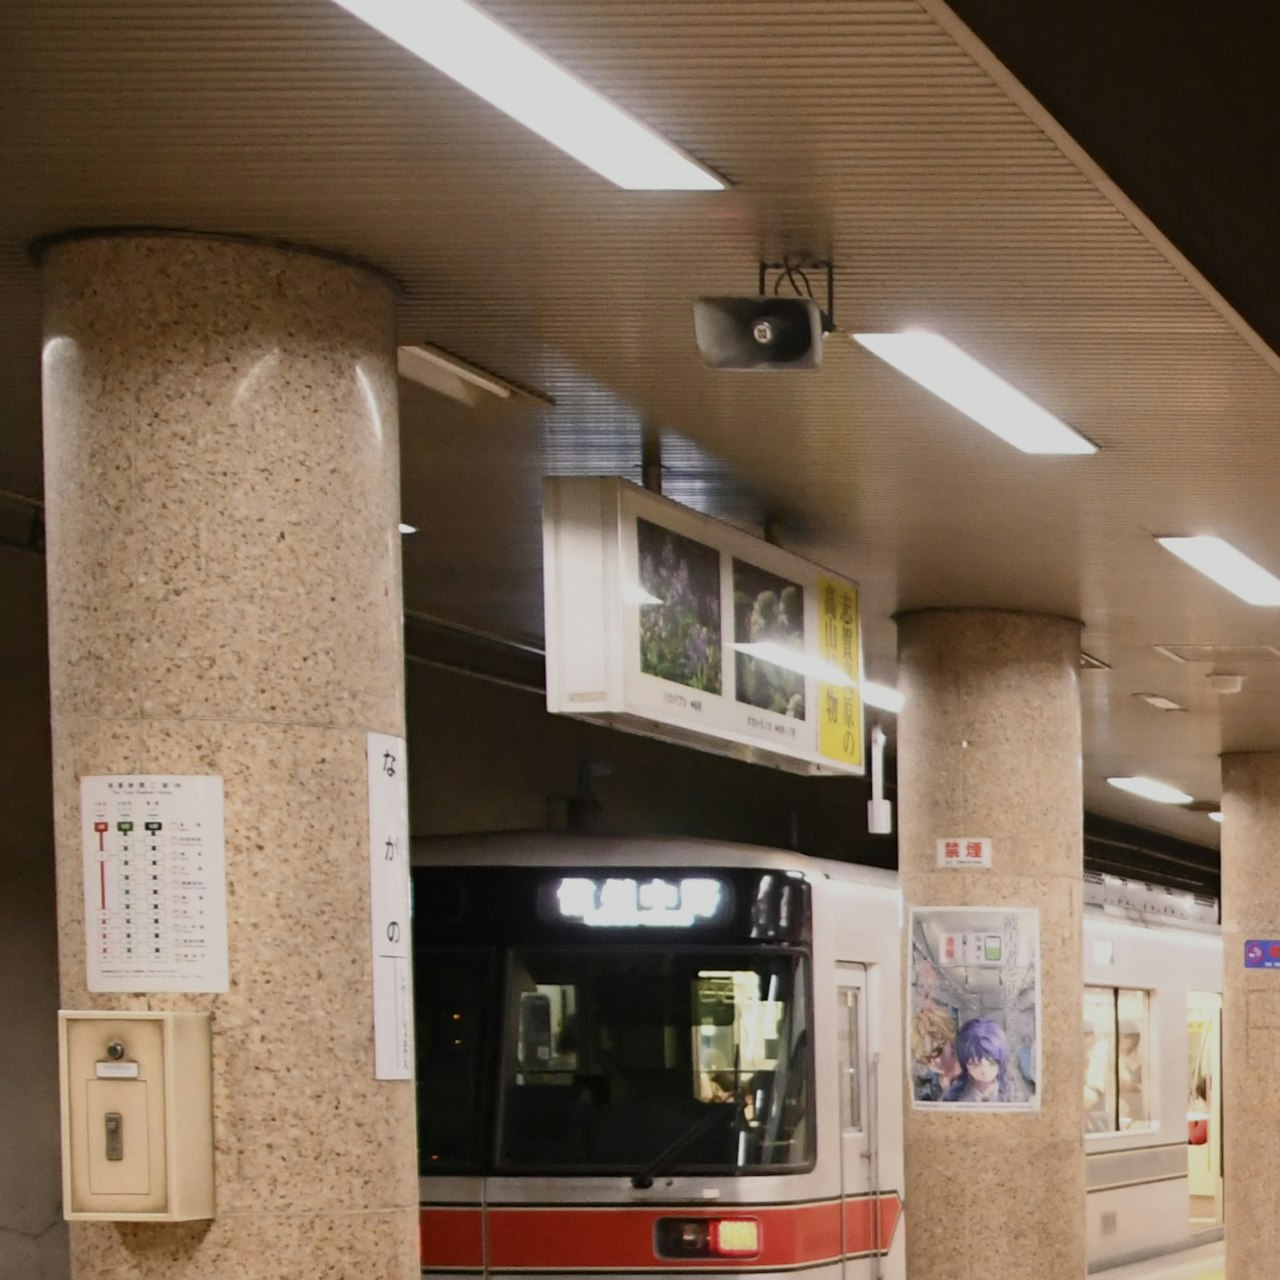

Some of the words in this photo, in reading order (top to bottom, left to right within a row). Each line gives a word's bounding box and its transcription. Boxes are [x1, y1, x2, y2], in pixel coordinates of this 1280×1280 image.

[825, 584, 838, 724] 高山物
[944, 842, 982, 859] 禁煙
